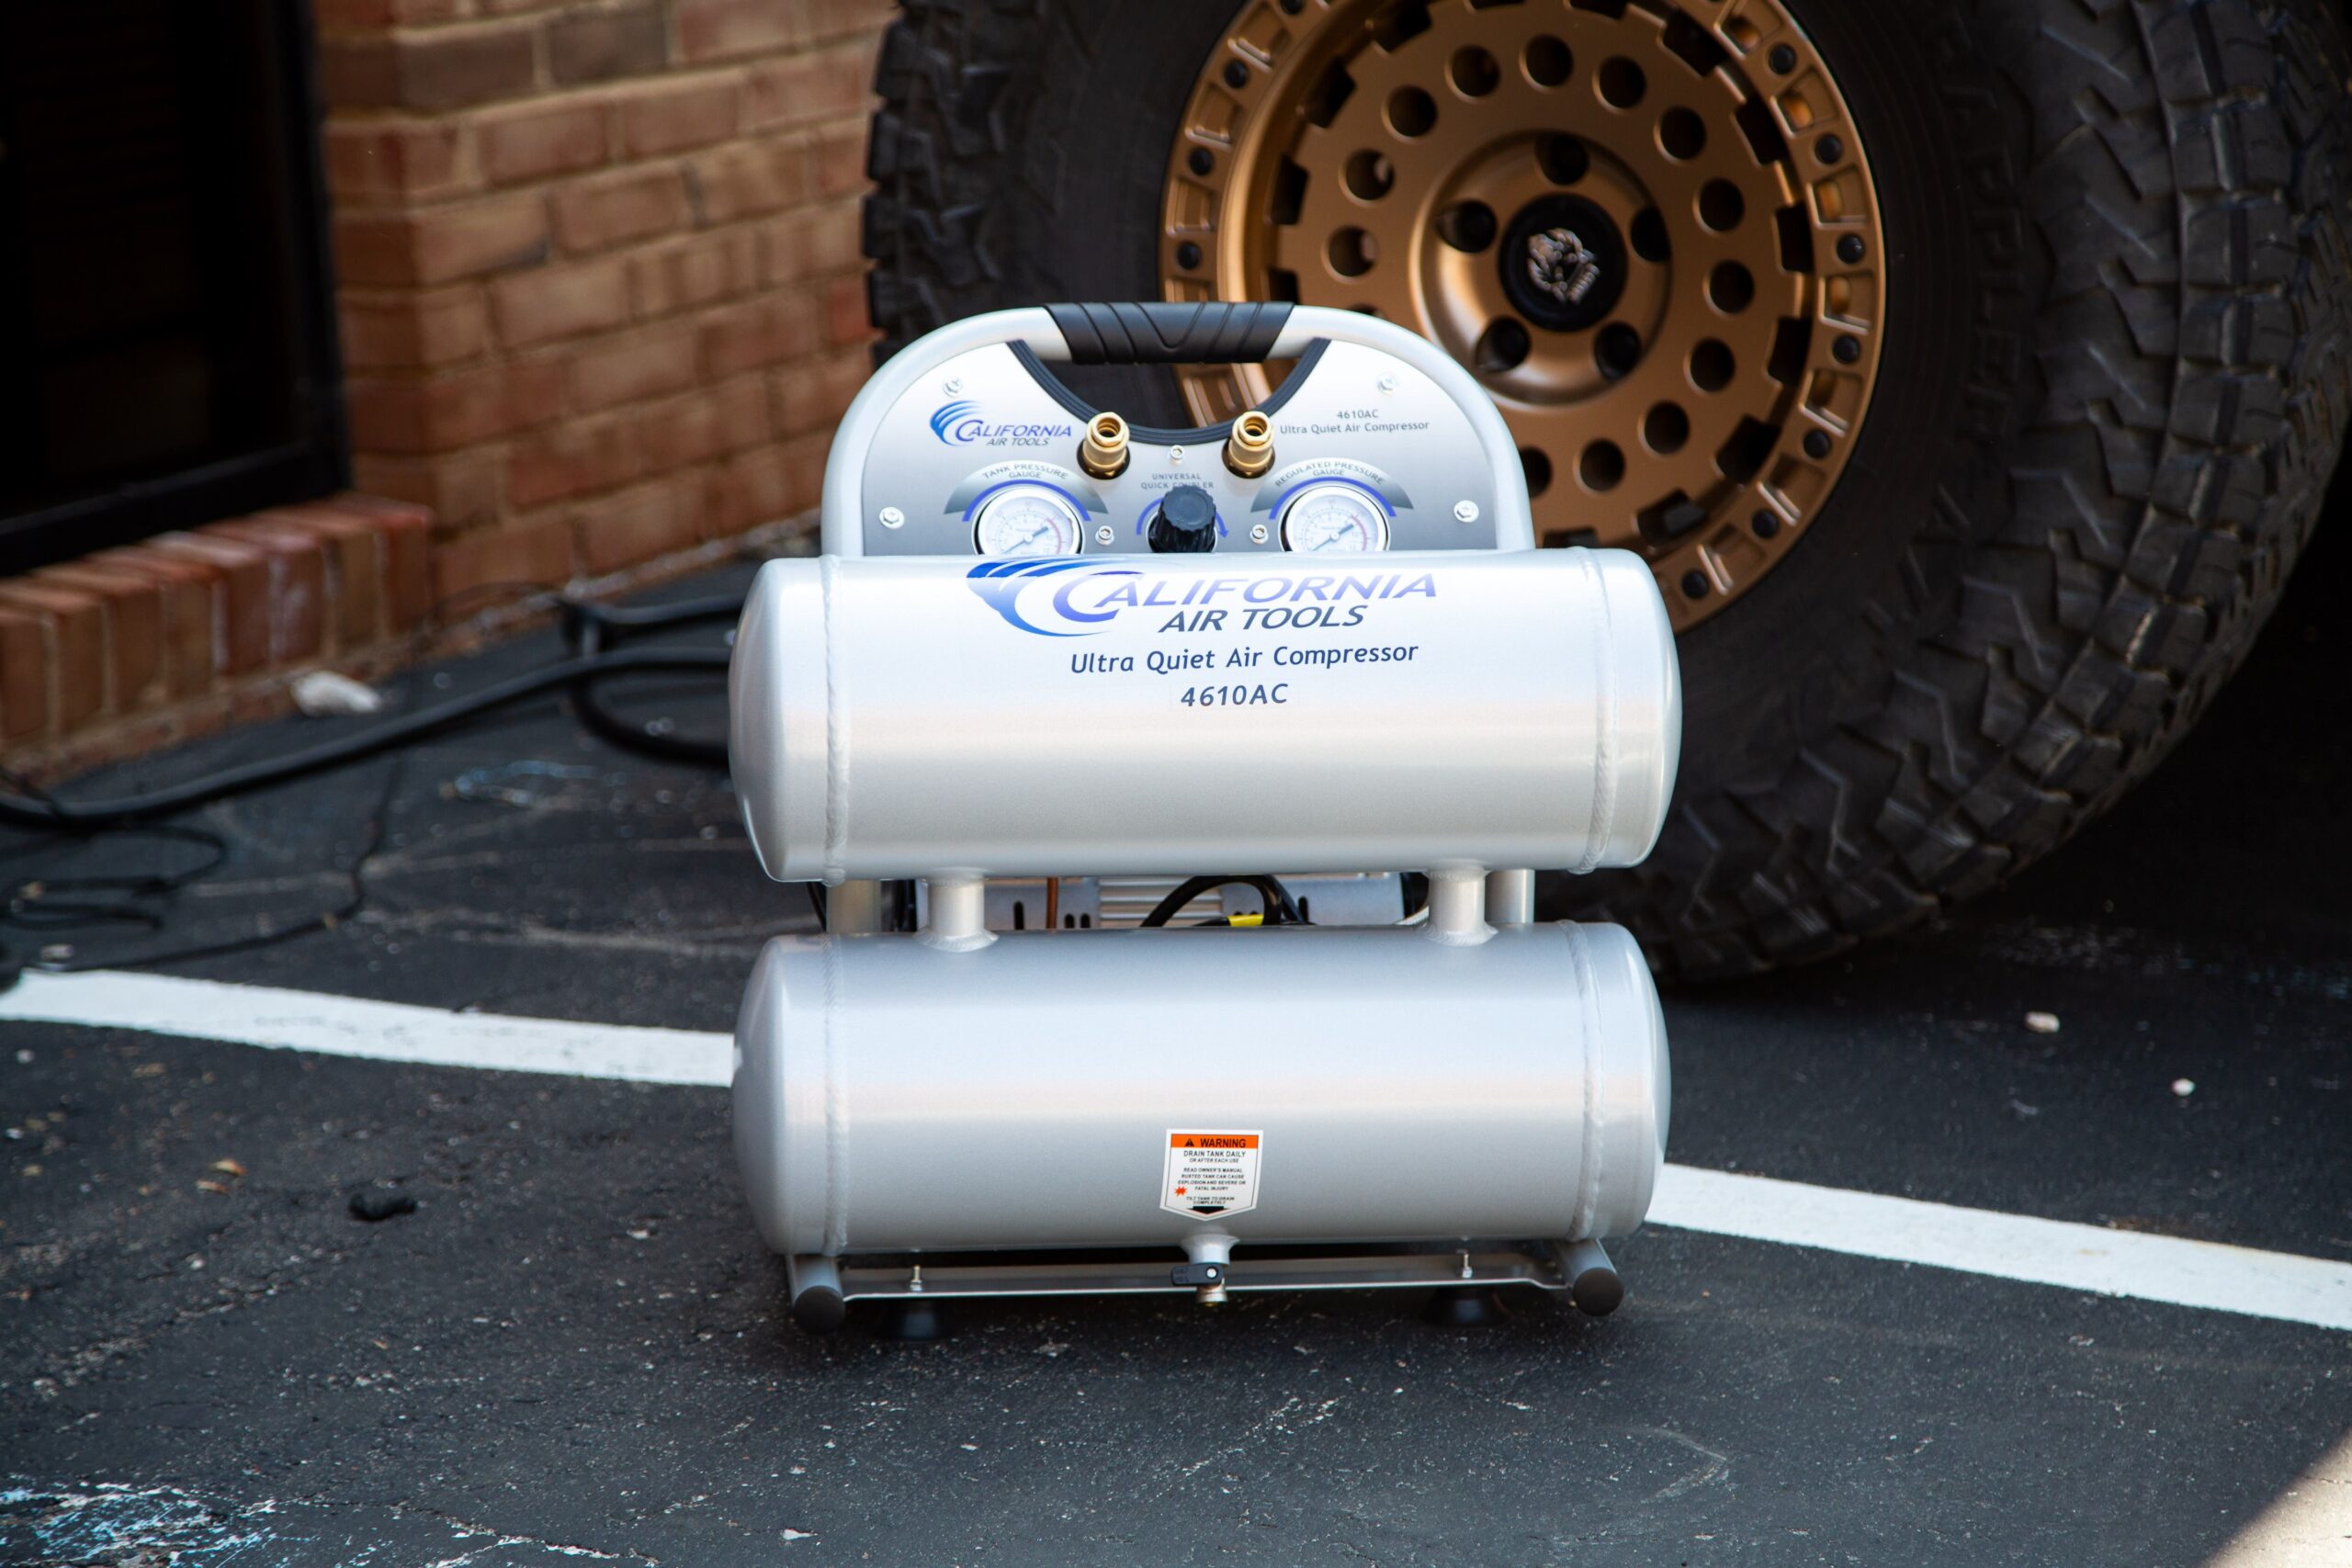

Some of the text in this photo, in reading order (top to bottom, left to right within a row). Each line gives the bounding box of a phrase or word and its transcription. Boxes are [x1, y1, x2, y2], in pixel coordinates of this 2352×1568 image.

[1337, 410, 1379, 420] 4610AC
[956, 420, 1071, 441] CALIFORNIA
[1280, 421, 1430, 435] Ultra Quiet Air Compressor
[986, 437, 1050, 446] AIR TOOLS
[982, 464, 1069, 479] TANK PRESSURE
[1151, 472, 1202, 480] UNIVERSAL
[1274, 462, 1385, 487] REGULATED PRESSURE
[1313, 468, 1344, 477] GAUGE
[1141, 481, 1169, 490] QUICK
[1053, 570, 1437, 623] CALIFORNIA
[1159, 604, 1369, 633] AIR TOOLS
[1070, 642, 1419, 675] Ultra Quiet Air Compressor
[1181, 683, 1288, 707] 4610AC
[1200, 1138, 1247, 1148] WARNING
